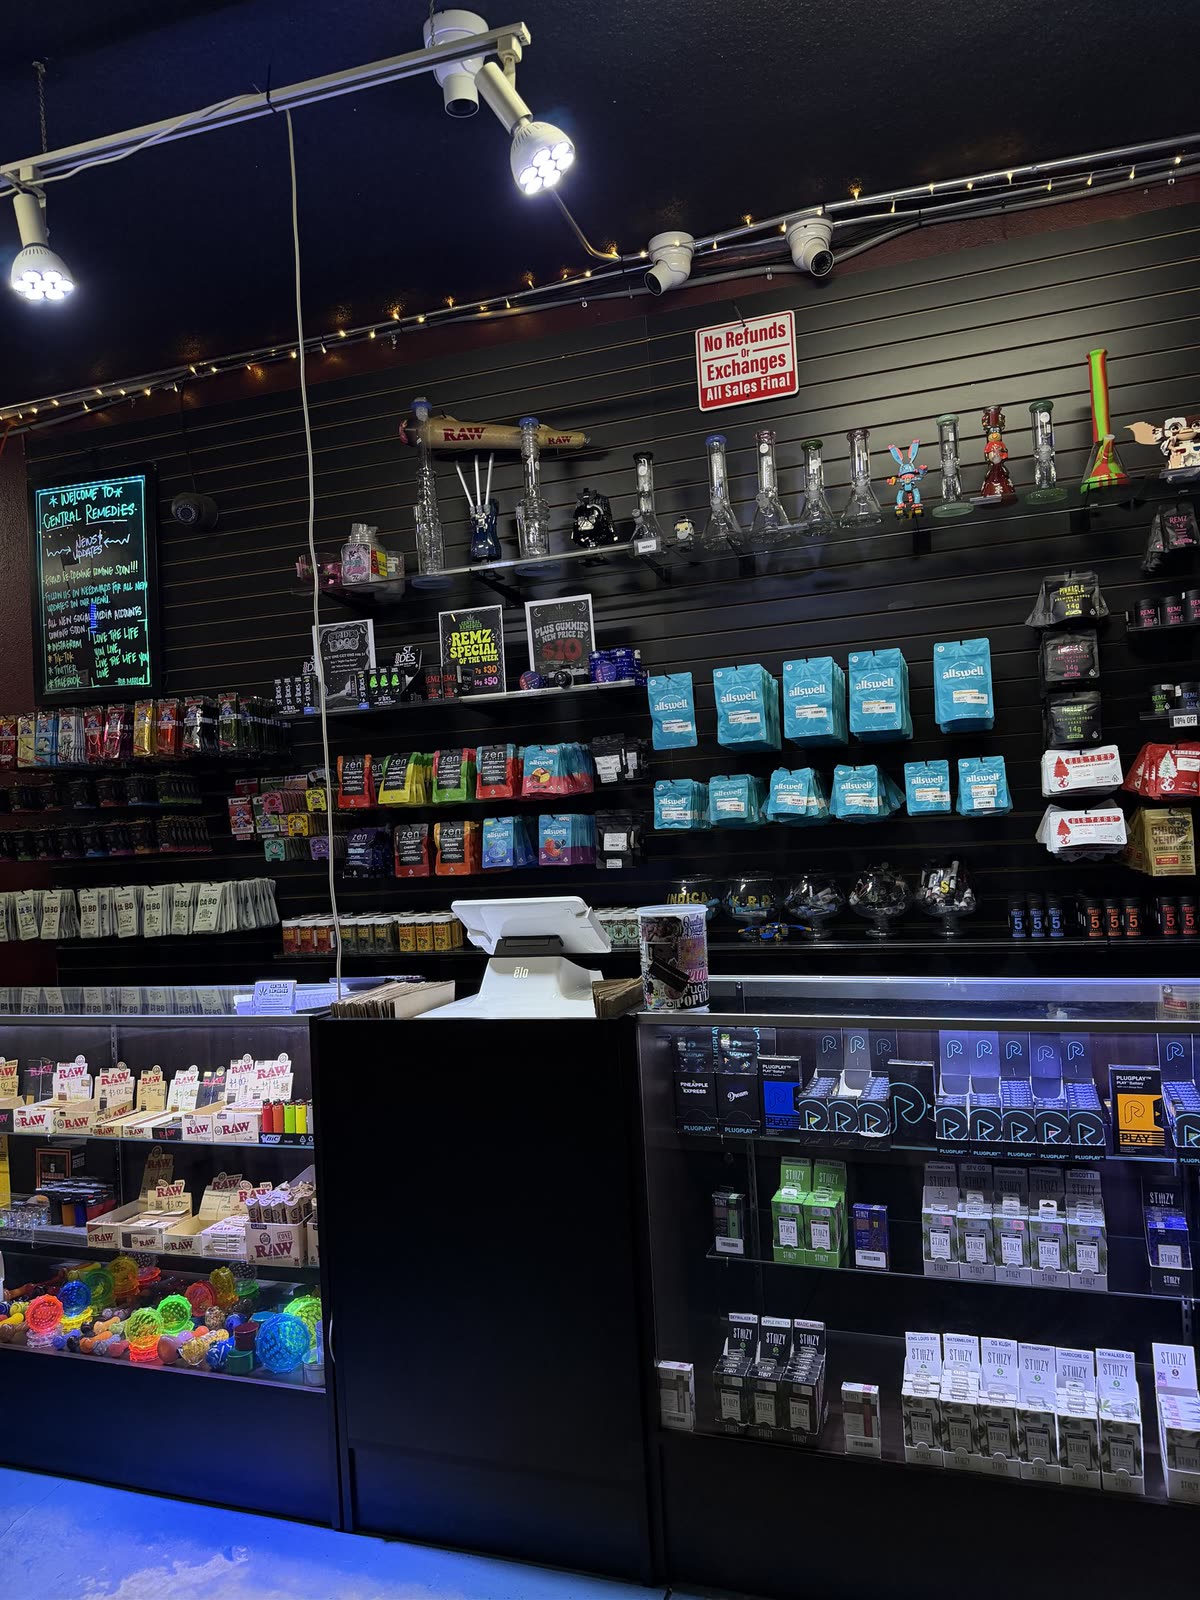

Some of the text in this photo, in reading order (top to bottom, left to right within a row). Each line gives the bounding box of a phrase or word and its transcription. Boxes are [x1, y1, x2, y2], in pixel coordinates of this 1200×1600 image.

[704, 322, 786, 352] No Refunds
[741, 348, 750, 358] Or
[707, 353, 786, 381] Exchanges
[706, 373, 790, 401] All Sales Final
[443, 427, 486, 441] RAW
[548, 435, 572, 445] RAW
[61, 485, 113, 506] WELCOME TO
[43, 509, 82, 529] CENTRAL
[1170, 515, 1187, 524] REMZ
[123, 582, 133, 591] ALL
[48, 618, 57, 629] ALL
[59, 615, 72, 627] NEW
[109, 628, 121, 640] THE
[123, 626, 139, 640] LIFE
[535, 621, 588, 638] PLUS GUMMIES
[451, 629, 492, 647] REMZ
[542, 630, 584, 643] NEW PRICE IS
[450, 643, 498, 659] SPECIAL
[542, 638, 582, 662] $10
[122, 652, 137, 665] LIFE
[468, 656, 480, 664] THE
[481, 654, 499, 662] WEEK
[484, 665, 497, 674] $30
[942, 665, 985, 679] allswell
[484, 677, 498, 685] $50
[856, 678, 894, 691] allswell
[720, 691, 757, 703] allswell
[789, 685, 826, 697] allswell
[654, 699, 688, 712] allswell
[1186, 715, 1197, 724] OFF
[441, 755, 459, 763] zen
[484, 751, 504, 759] zen
[345, 760, 362, 769] zen
[390, 758, 407, 766] zen
[911, 775, 944, 784] allswell
[966, 773, 999, 783] allswell
[841, 782, 873, 790] allswell
[402, 831, 420, 839] zen
[442, 828, 461, 836] zen
[1014, 917, 1023, 930] 5
[1033, 917, 1042, 930] 5
[1052, 916, 1061, 929] 5
[1091, 916, 1100, 929] 5
[1110, 915, 1119, 928] 5
[1129, 915, 1138, 928] 5
[1166, 914, 1175, 927] 5
[1185, 913, 1194, 926] 5
[58, 1066, 85, 1079] RAW
[231, 1064, 253, 1074] RAW
[256, 1064, 288, 1080] RAW
[101, 1071, 129, 1086] RAW
[142, 1076, 161, 1085] RAW
[175, 1076, 196, 1085] RAW
[727, 1090, 749, 1102] Dream
[20, 1114, 46, 1127] RAW
[64, 1117, 89, 1129] RAW
[97, 1127, 115, 1135] RAW
[187, 1125, 209, 1135] RAW
[222, 1122, 250, 1134] RAW
[1121, 1133, 1151, 1143] PLAY
[213, 1178, 242, 1190] RAW
[157, 1185, 183, 1197] RAW
[94, 1232, 114, 1242] RAW
[139, 1238, 156, 1247] RAW
[170, 1241, 193, 1250] RAW
[255, 1242, 293, 1258] RAW
[1061, 1351, 1083, 1359] HARDCORE
[1099, 1351, 1125, 1359] SKYWALKER
